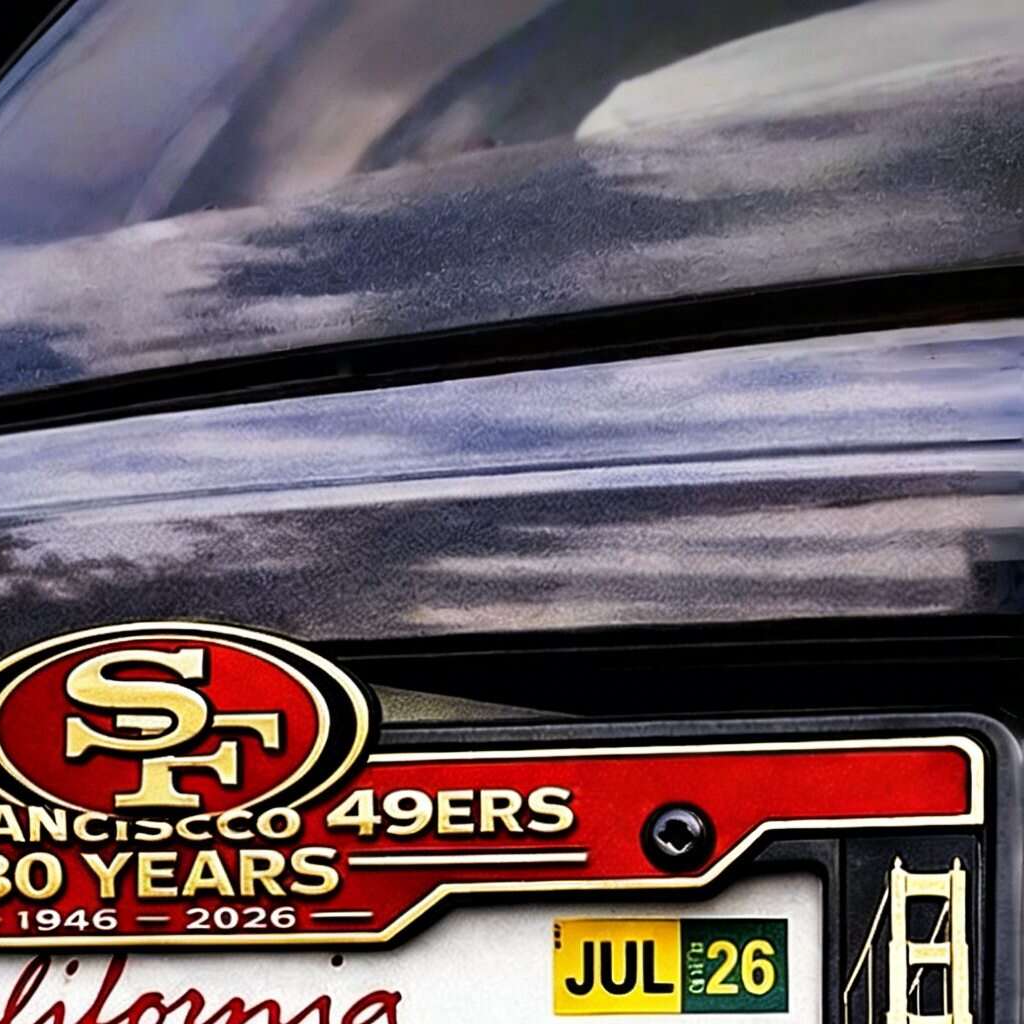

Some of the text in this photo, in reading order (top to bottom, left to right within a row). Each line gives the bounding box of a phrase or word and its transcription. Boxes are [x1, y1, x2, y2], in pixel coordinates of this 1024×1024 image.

[64, 647, 280, 809] SF
[326, 788, 575, 838] 49ERS
[80, 846, 340, 899] YEARS
[16, 906, 297, 932] 1946 2026
[564, 939, 675, 997] JUL
[705, 938, 776, 996] 26
